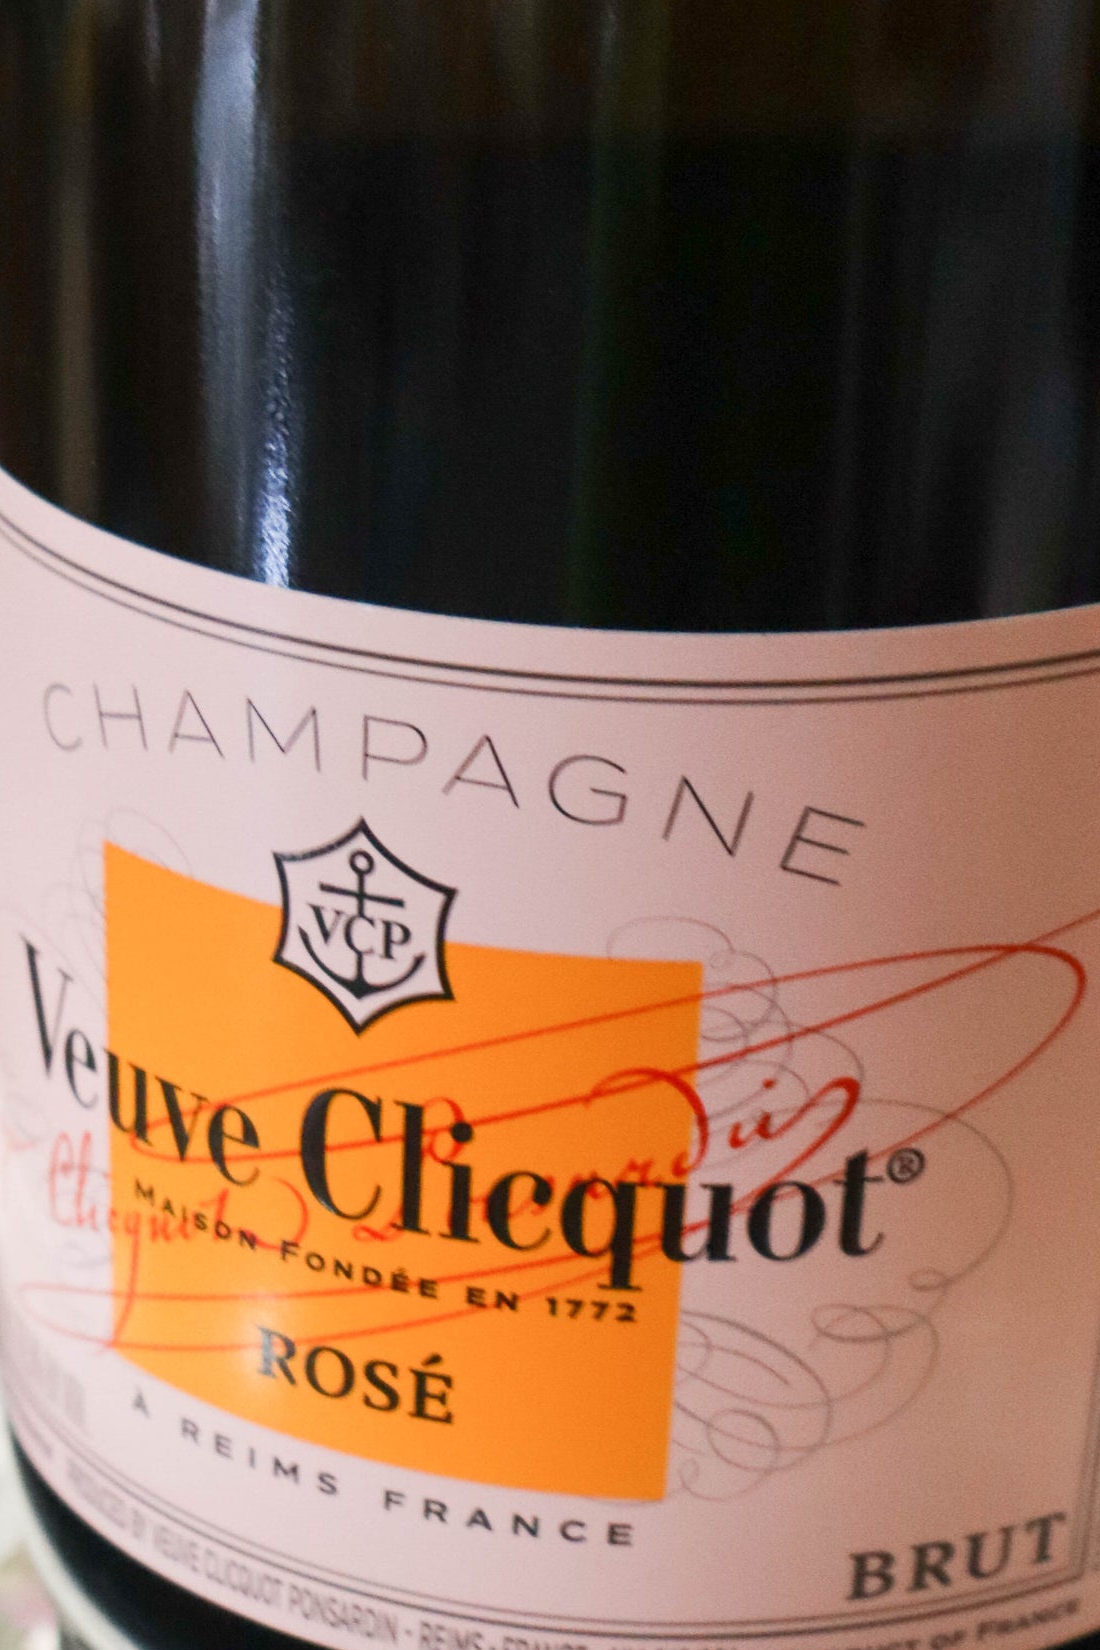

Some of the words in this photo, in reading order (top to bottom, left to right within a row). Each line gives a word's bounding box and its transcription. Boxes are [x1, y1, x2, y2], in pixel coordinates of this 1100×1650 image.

[42, 682, 866, 887] CHAMPAGNE
[308, 902, 412, 962] VCP
[19, 932, 262, 1187] Veuve
[135, 1177, 259, 1253] MAISON
[280, 1239, 440, 1300] FONDÉE
[465, 1283, 520, 1313] EN
[545, 1297, 638, 1324] 1772
[256, 1324, 455, 1426] ROSÉ
[180, 1416, 340, 1497] REIMS
[384, 1489, 636, 1547] FRANCE
[845, 1510, 1068, 1601] BRUT
